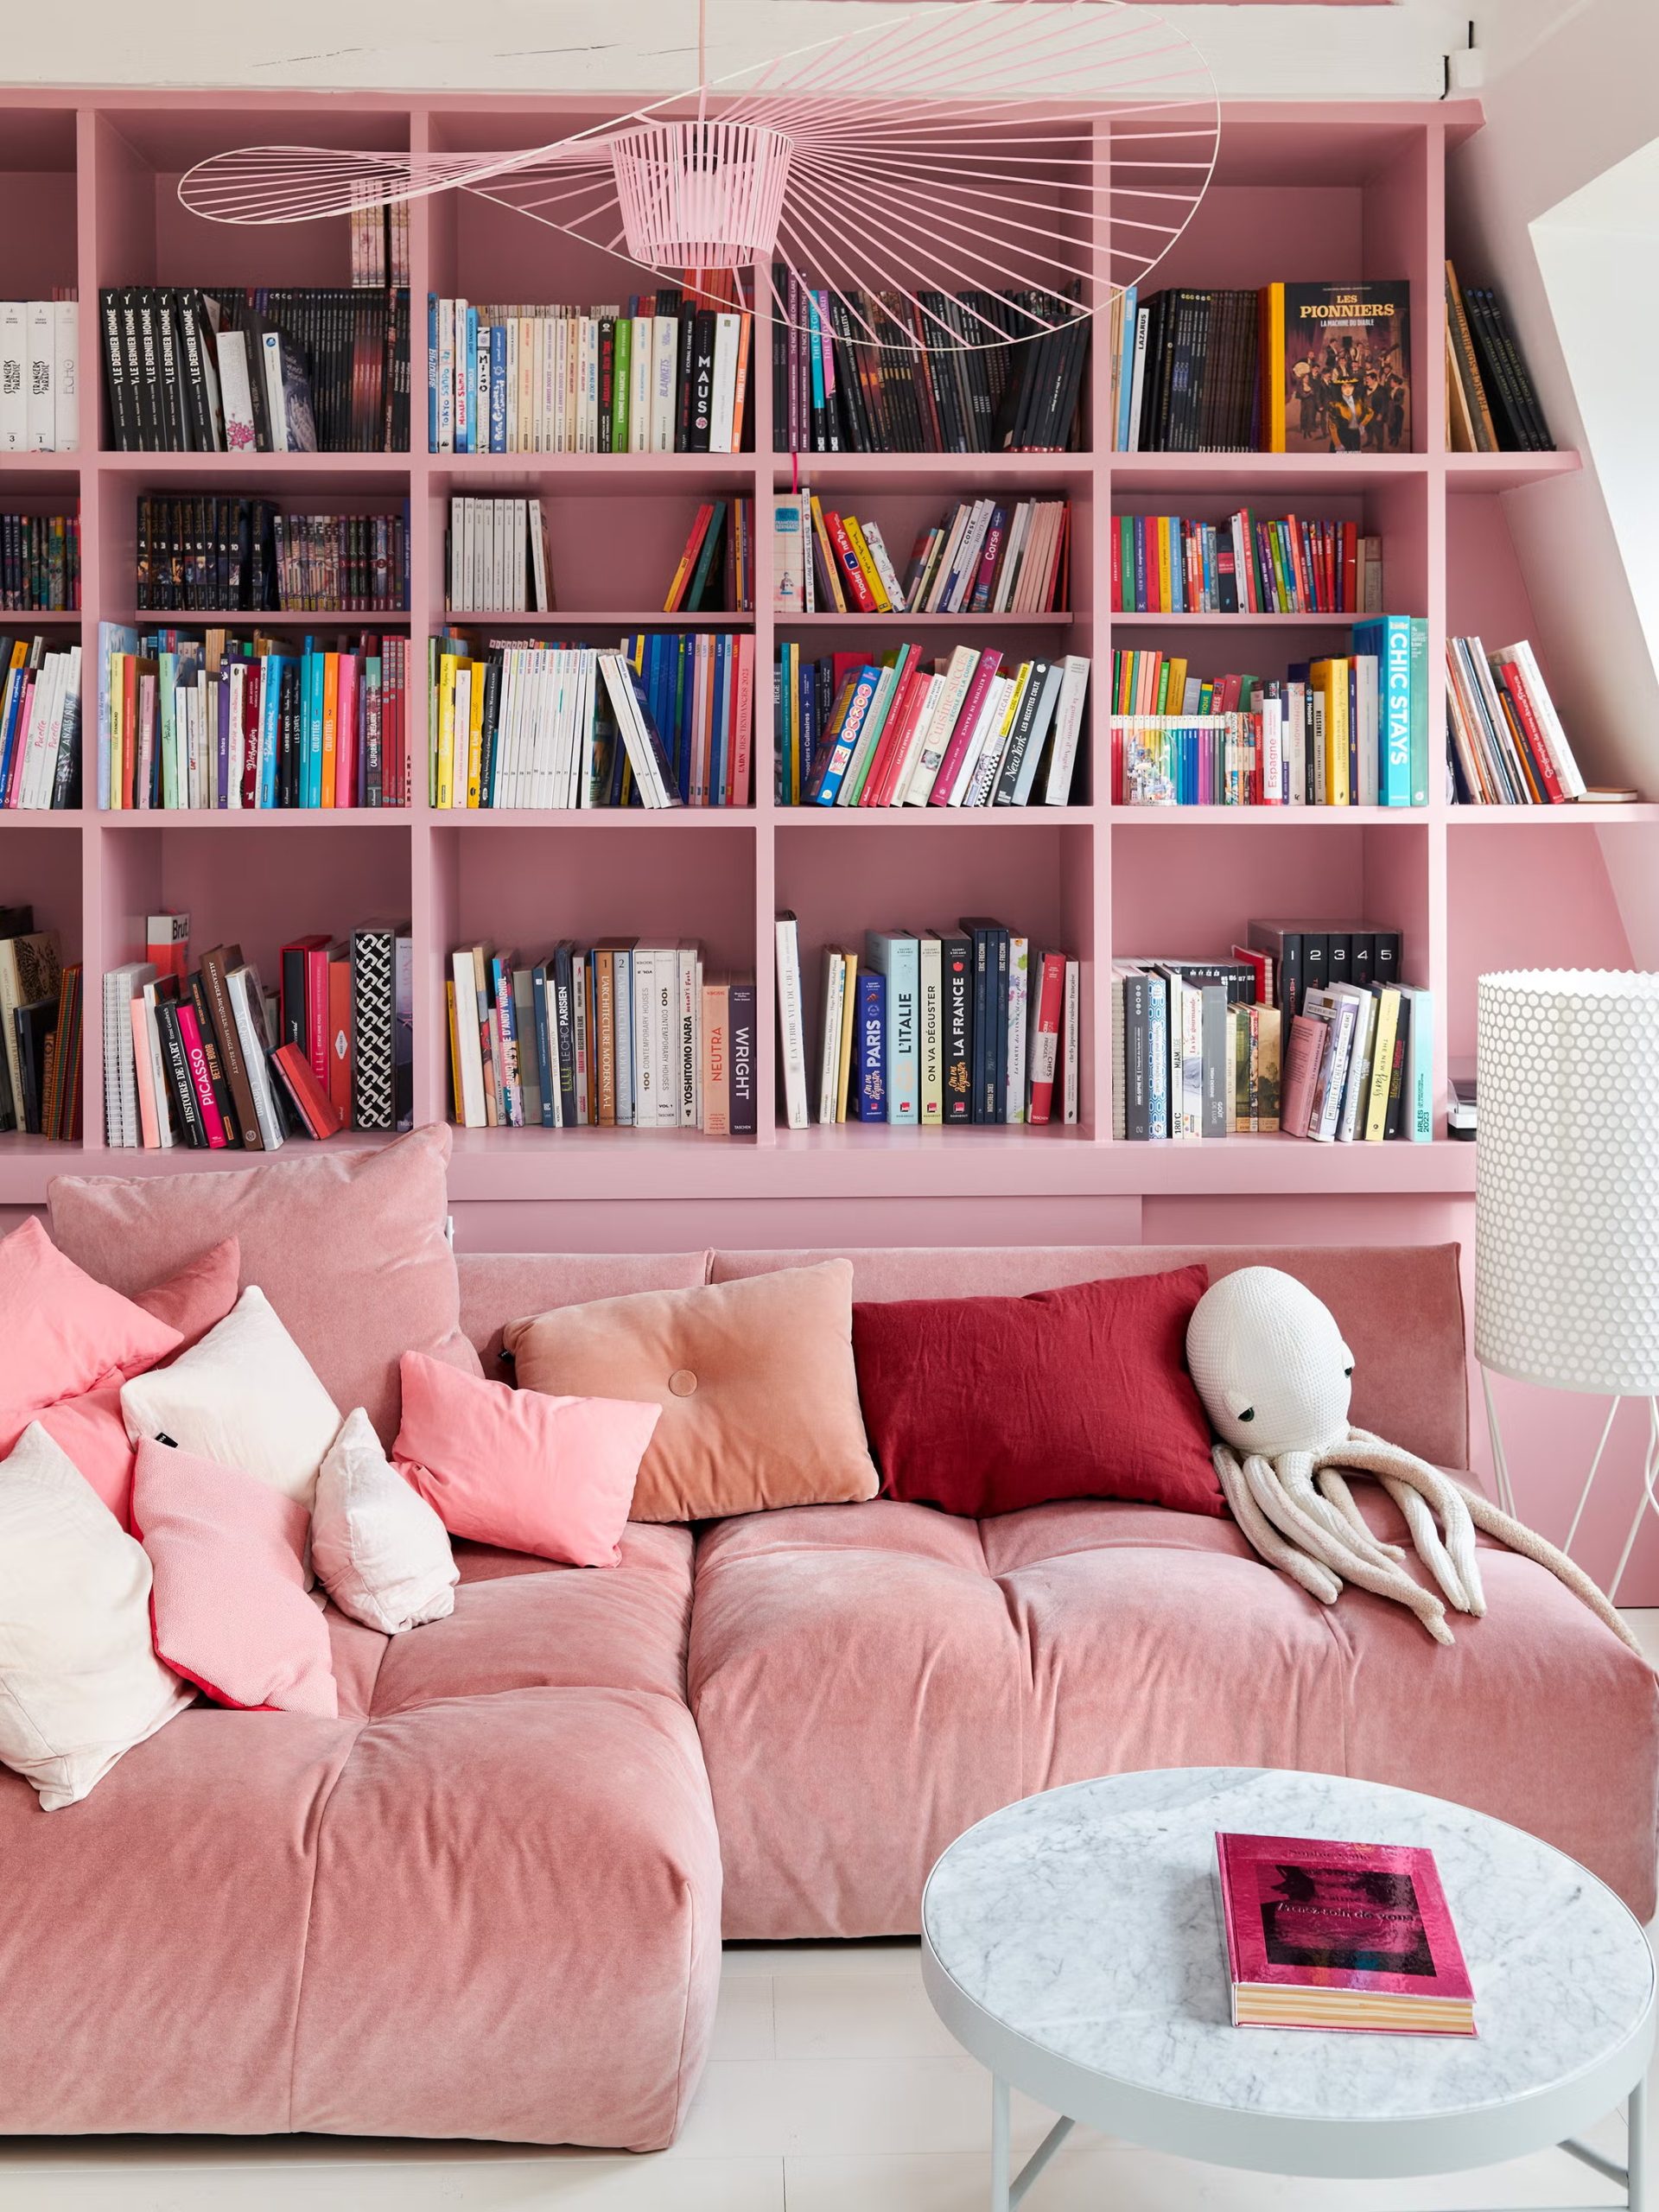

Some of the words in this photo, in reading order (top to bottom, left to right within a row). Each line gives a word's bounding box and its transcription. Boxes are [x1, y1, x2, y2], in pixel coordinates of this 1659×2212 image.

[1300, 304, 1395, 318] PIONNIERS
[1337, 295, 1357, 303] LES
[107, 309, 118, 335] HOMME
[124, 308, 135, 335] HOMME
[142, 308, 151, 335] HOMME
[161, 308, 170, 335] HOMME
[183, 309, 194, 335] HOMME
[1455, 301, 1471, 347] HISTOIRE
[109, 336, 121, 366] DERNIER
[127, 336, 138, 365] DERNIER
[143, 336, 154, 365] DERNIER
[162, 336, 173, 365] DERNIER
[187, 336, 199, 366] DERNIER
[1466, 349, 1477, 368] SON
[3, 360, 16, 394] STRANGERS
[33, 361, 45, 394] STRANGERS
[62, 359, 73, 394] ECHO
[660, 359, 670, 397] BLANKETS
[697, 356, 710, 413] MAUS
[1471, 372, 1488, 412] FRANCE
[964, 519, 976, 544] CORSE
[985, 531, 1000, 561] Corse
[852, 570, 867, 600] Japon
[1390, 632, 1408, 689] CHIC
[956, 688, 963, 696] DE
[963, 655, 975, 678] CUISINE
[1030, 681, 1040, 696] CULTE
[1514, 676, 1527, 701] France
[972, 678, 986, 704] KITCHEN
[997, 684, 1013, 717] ALCALIN
[926, 696, 952, 745] Cuisine
[1023, 697, 1036, 721] RECETTES
[961, 714, 974, 737] FRANCE
[1020, 721, 1029, 732] LES
[1390, 696, 1408, 766] STAYS
[1011, 734, 1027, 757] York
[1005, 756, 1021, 781] New
[1268, 739, 1278, 787] Espagne
[172, 919, 189, 940] Brut
[618, 959, 626, 969] 2
[1310, 950, 1321, 960] 2
[1334, 950, 1345, 960] 3
[1357, 950, 1368, 960] 4
[1381, 950, 1391, 960] 5
[498, 976, 509, 1007] WARHOL
[787, 988, 793, 1000] DU
[208, 962, 222, 996] ALEXANDER
[223, 1029, 232, 1050] SAVAGE
[229, 1051, 239, 1074] BEAUTY
[558, 986, 569, 1026] PARISIEN
[601, 975, 610, 1046] L'ARCHITECTURE
[618, 974, 628, 1044] L'ARCHITECTURE
[925, 985, 936, 1043] DÉGUSTER
[952, 977, 964, 1035] FRANCE
[235, 1010, 251, 1056] McQueen
[499, 1009, 512, 1035] D'ANDY
[683, 1016, 692, 1044] NARA
[788, 1020, 798, 1045] TERRE
[899, 993, 912, 1053] L'ITALIE
[205, 1043, 217, 1059] BOOB
[503, 1037, 512, 1063] MONDE
[560, 1027, 569, 1051] CHIC
[867, 1020, 880, 1067] PARIS
[953, 1041, 964, 1057] LA
[169, 1041, 182, 1065] L'ART
[562, 1051, 570, 1062] LE
[711, 1027, 722, 1082] NEUTRA
[735, 1027, 749, 1100] WRIGHT
[791, 1048, 798, 1058] LA
[928, 1048, 936, 1060] VA
[175, 1066, 185, 1079] DE
[191, 1048, 214, 1106] PICASSO
[209, 1062, 221, 1079] BETTY
[504, 1065, 513, 1090] GRAND
[601, 1048, 611, 1093] MODERNE
[619, 1046, 628, 1091] MODERNE
[683, 1046, 693, 1105] YOSHITOMO
[865, 1074, 871, 1084] va
[928, 1065, 936, 1082] ON
[950, 1065, 957, 1077] va
[955, 1061, 970, 1093] déguster
[1332, 1064, 1343, 1090] KITCHEN
[863, 1084, 872, 1095] On
[870, 1071, 885, 1100] déguster
[948, 1077, 957, 1088] On
[1373, 1074, 1389, 1096] Paris
[179, 1081, 195, 1122] HISTOIRE
[507, 1092, 515, 1101] LE
[602, 1095, 612, 1109] A-L
[1328, 1091, 1338, 1117] MIDLIFE
[1277, 1903, 1319, 1916] Prenez
[1319, 1909, 1350, 1919] soin
[1355, 1910, 1374, 1920] de
[1377, 1914, 1414, 1923] vous
